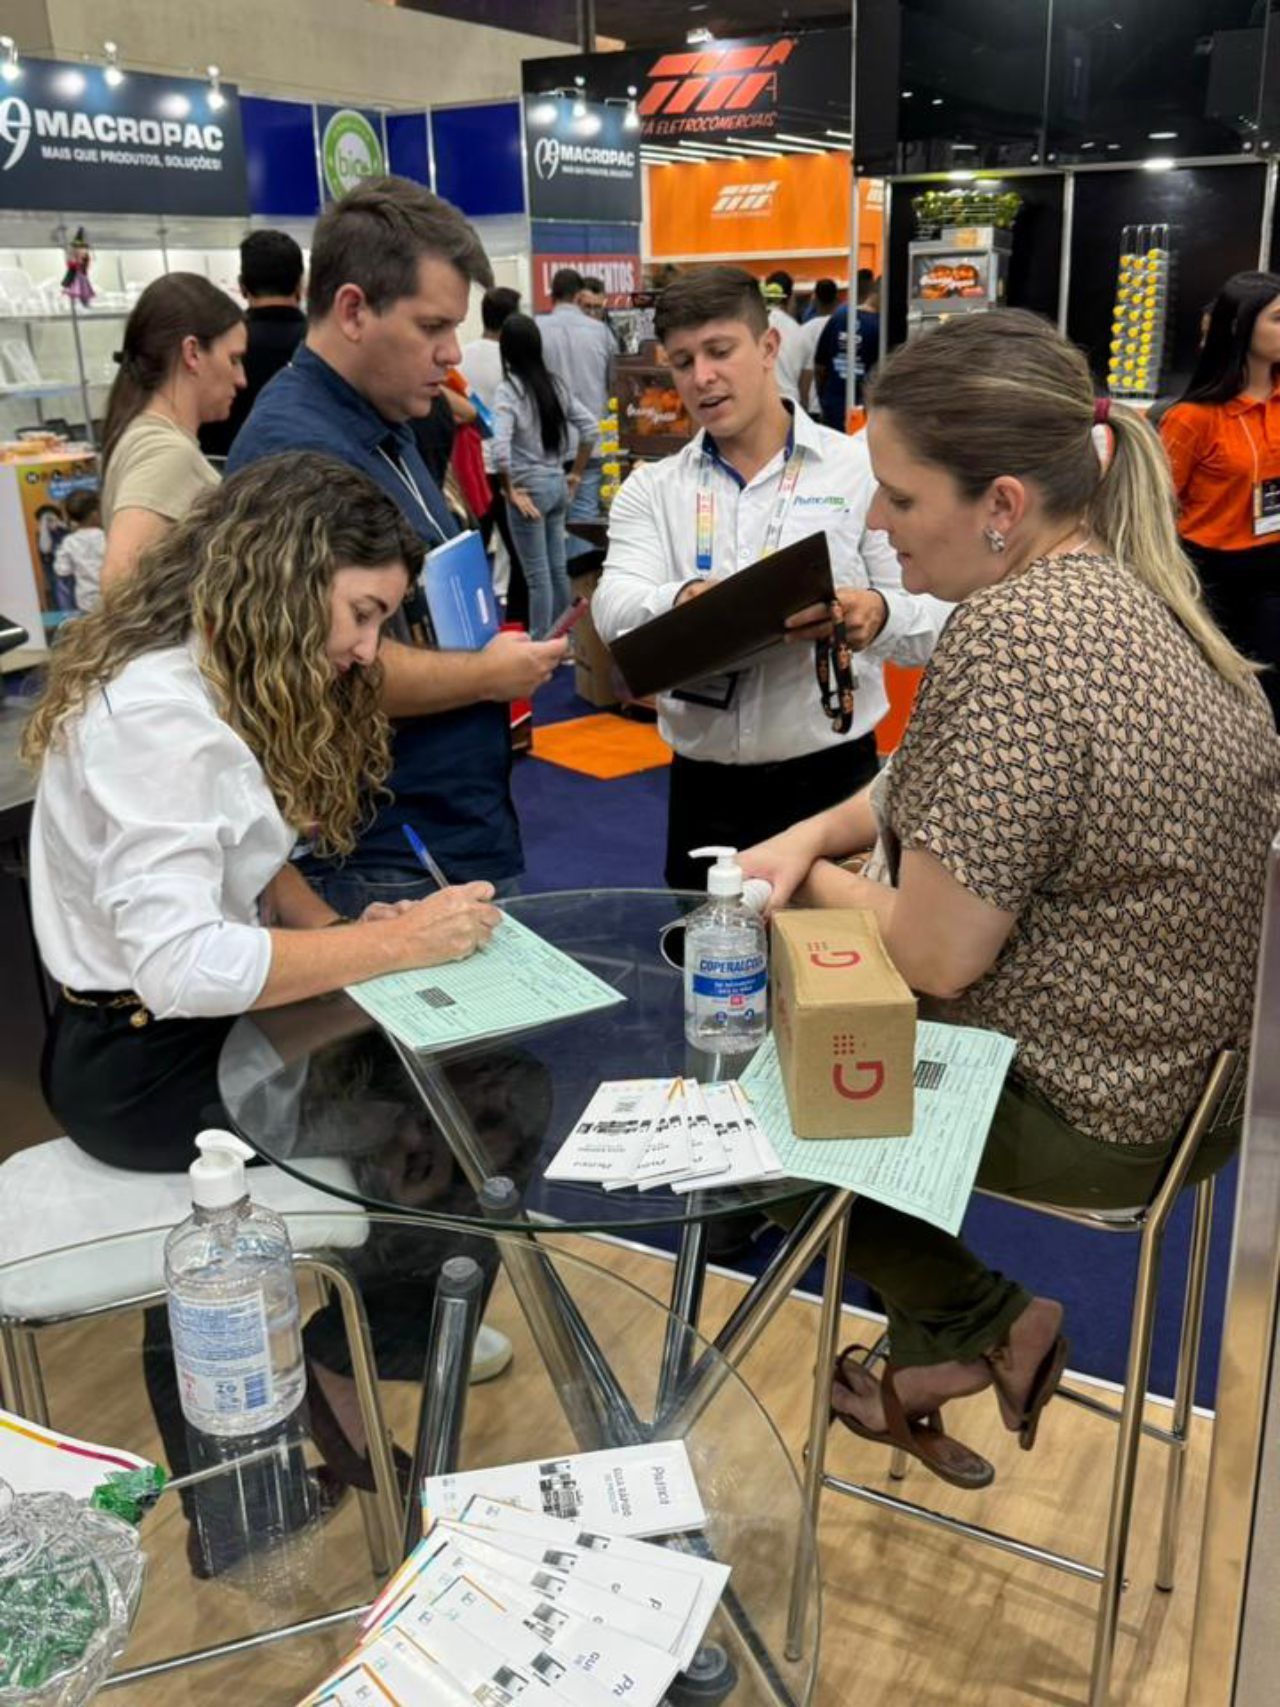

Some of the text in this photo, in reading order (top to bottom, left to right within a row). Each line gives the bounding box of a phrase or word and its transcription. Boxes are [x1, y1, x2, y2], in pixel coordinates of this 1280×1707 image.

[34, 109, 224, 151] MACROPAC
[74, 149, 98, 163] QUE
[561, 144, 635, 167] MACROPAC
